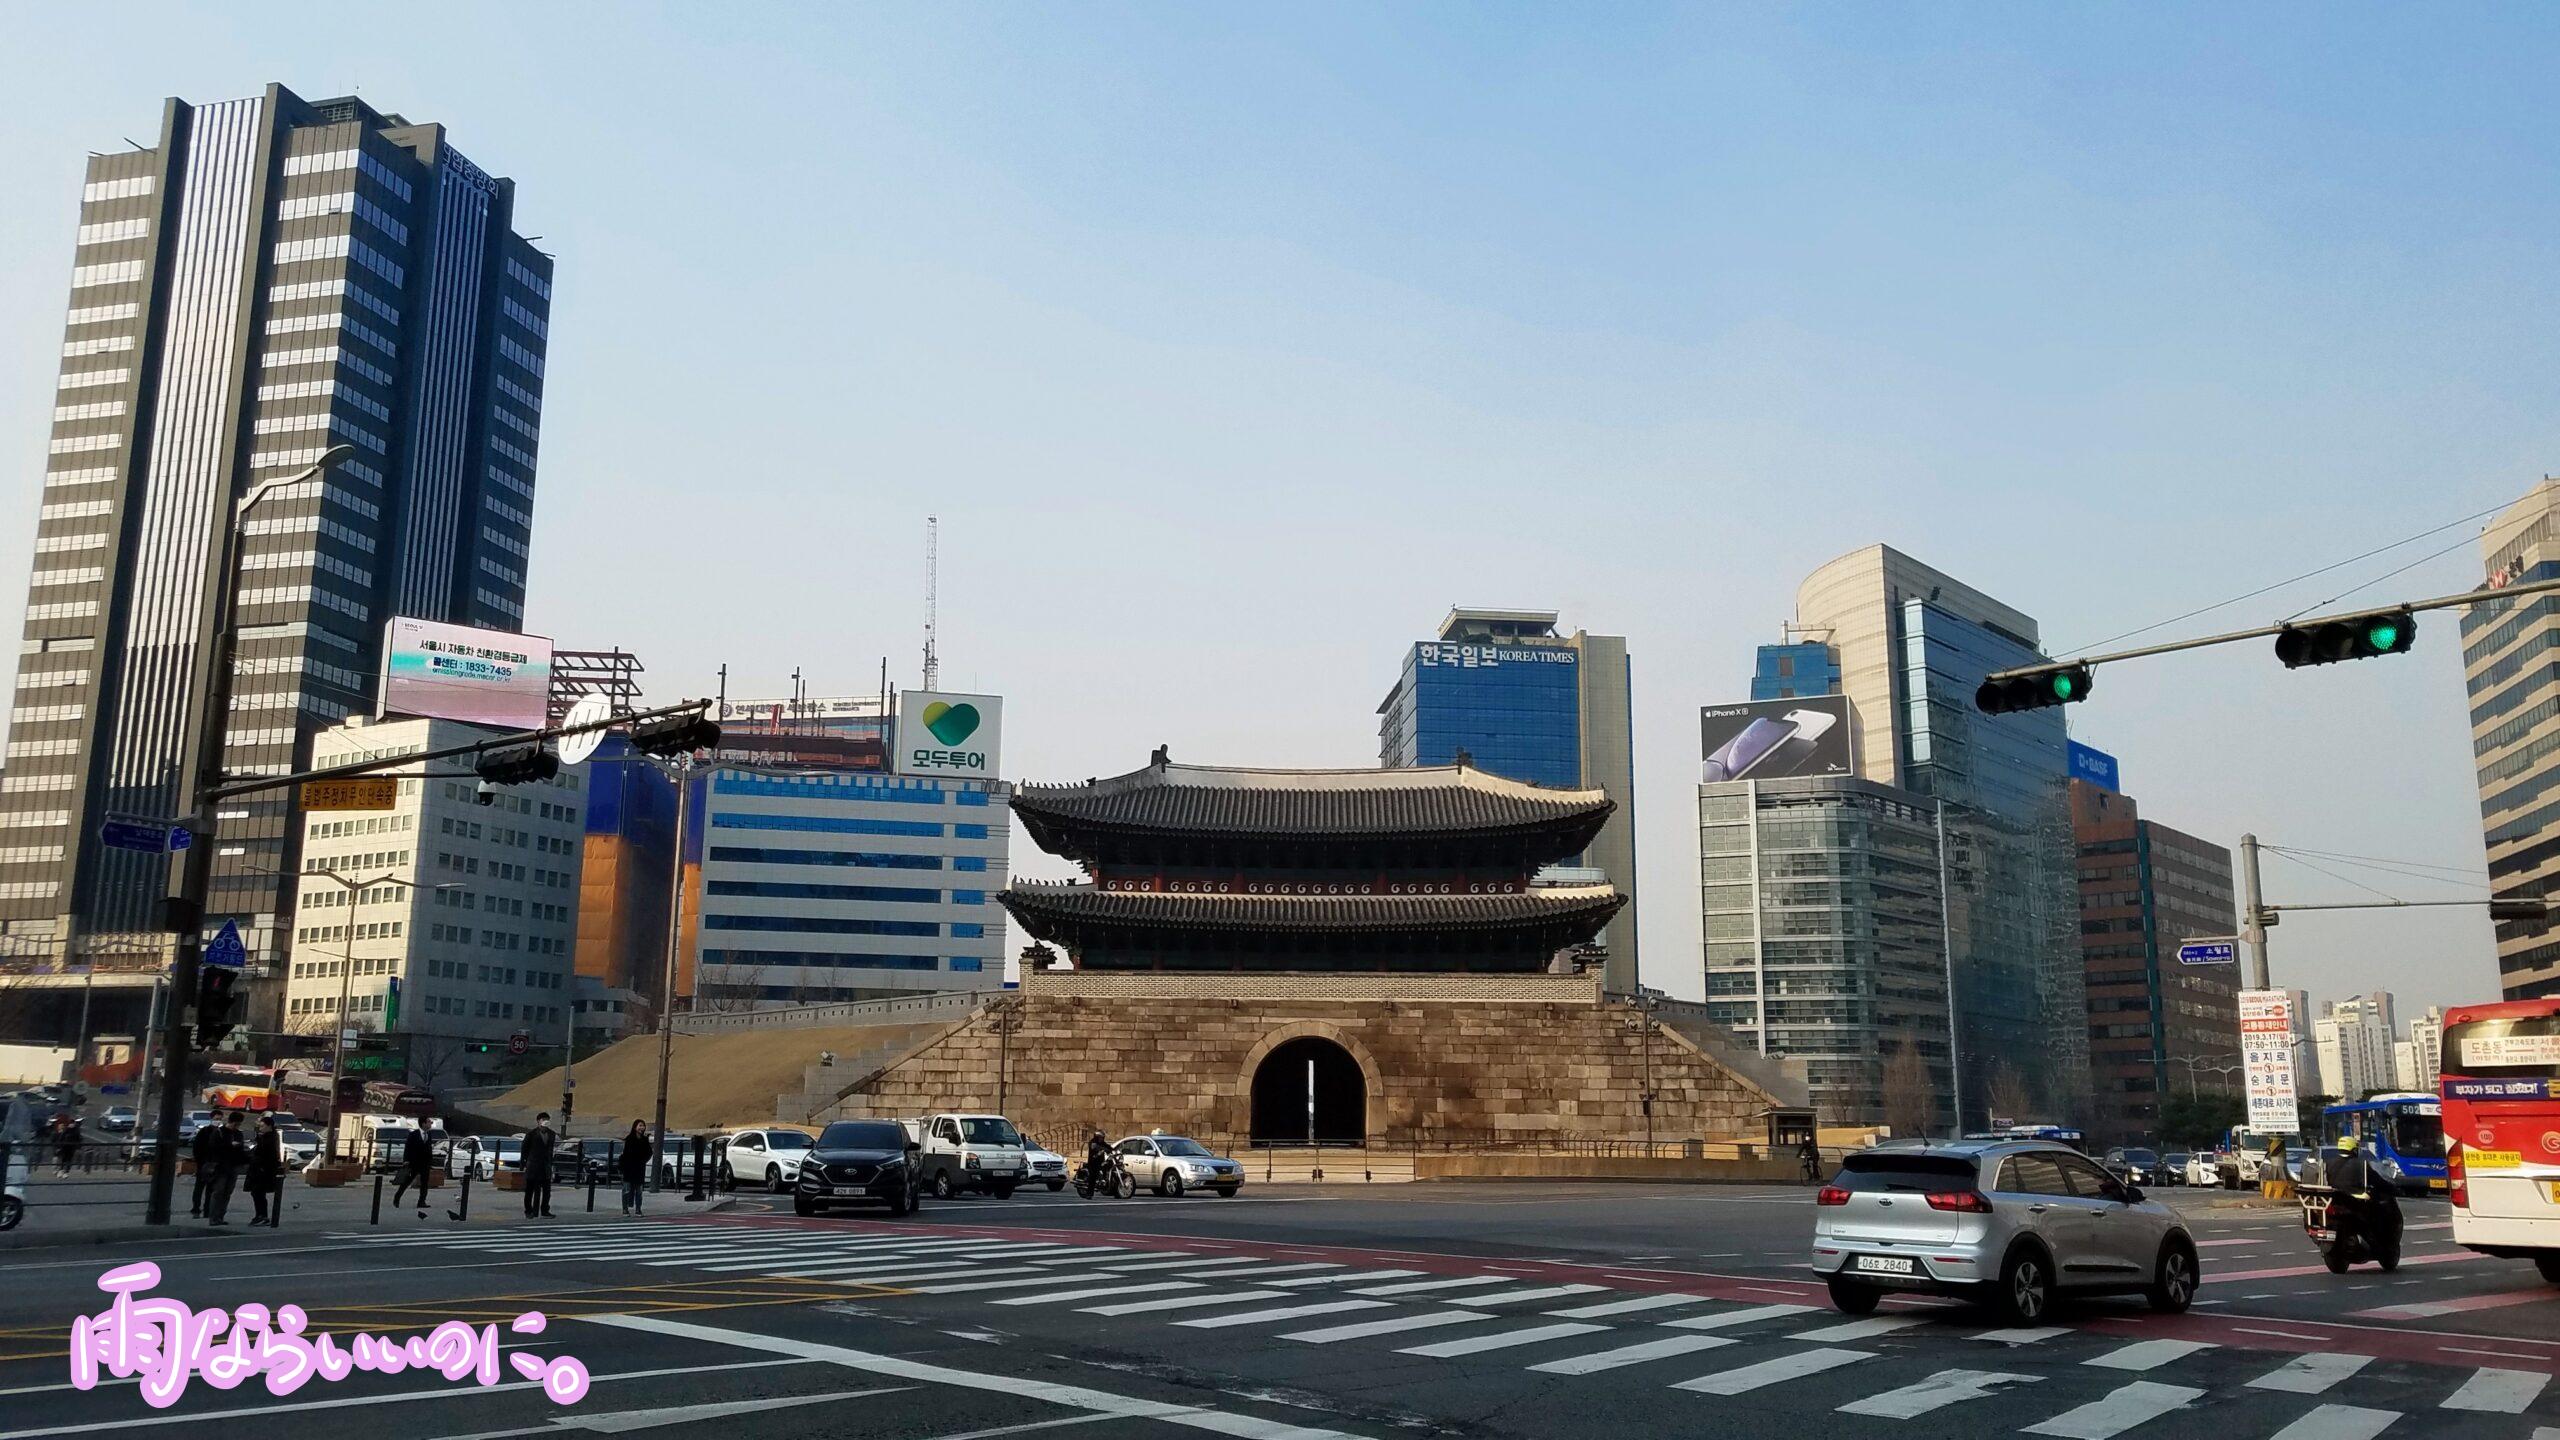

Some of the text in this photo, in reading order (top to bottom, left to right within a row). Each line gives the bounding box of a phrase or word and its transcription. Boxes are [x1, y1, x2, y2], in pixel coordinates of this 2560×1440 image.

[419, 639, 528, 664] 서울시 자동차 친환경등급제
[1420, 644, 1574, 668] 한국일보 KOREA TIMES
[433, 657, 458, 669] 콜센터
[465, 661, 512, 677] 1833-7435
[912, 749, 985, 771] 모두투어
[513, 1040, 524, 1049] 50
[2471, 1041, 2502, 1055] 도촌동
[2455, 1085, 2483, 1095] 부자가
[2485, 1084, 2504, 1095] 되고
[2252, 1097, 2294, 1109] 세종대로 사거리
[1883, 1259, 1908, 1271] 2840
